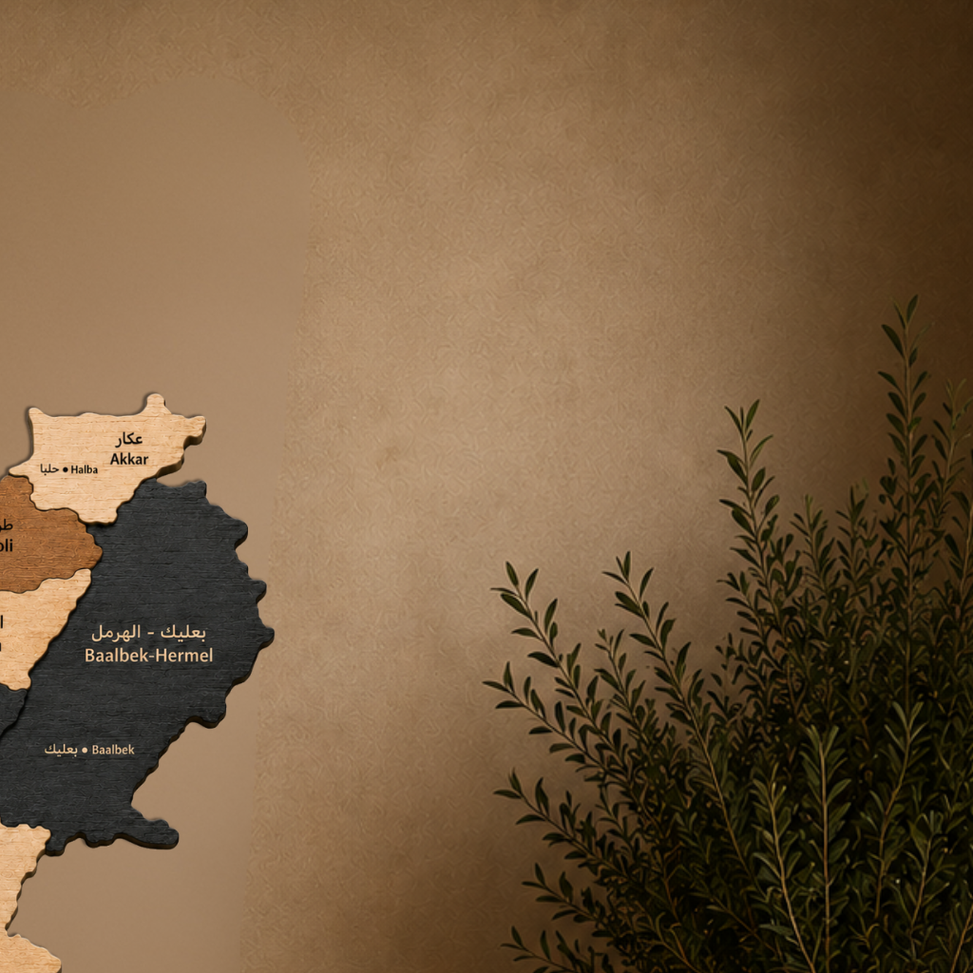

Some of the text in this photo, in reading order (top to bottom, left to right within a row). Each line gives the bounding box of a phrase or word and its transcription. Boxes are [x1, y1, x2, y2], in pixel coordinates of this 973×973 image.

[114, 431, 143, 449] عكار
[109, 451, 149, 466] Akkar
[40, 463, 60, 476] حلبا
[70, 464, 99, 474] Halba
[91, 624, 141, 643] الهرمل
[85, 647, 213, 663] Baalbek-Hermel
[92, 743, 135, 755] Baalbek
